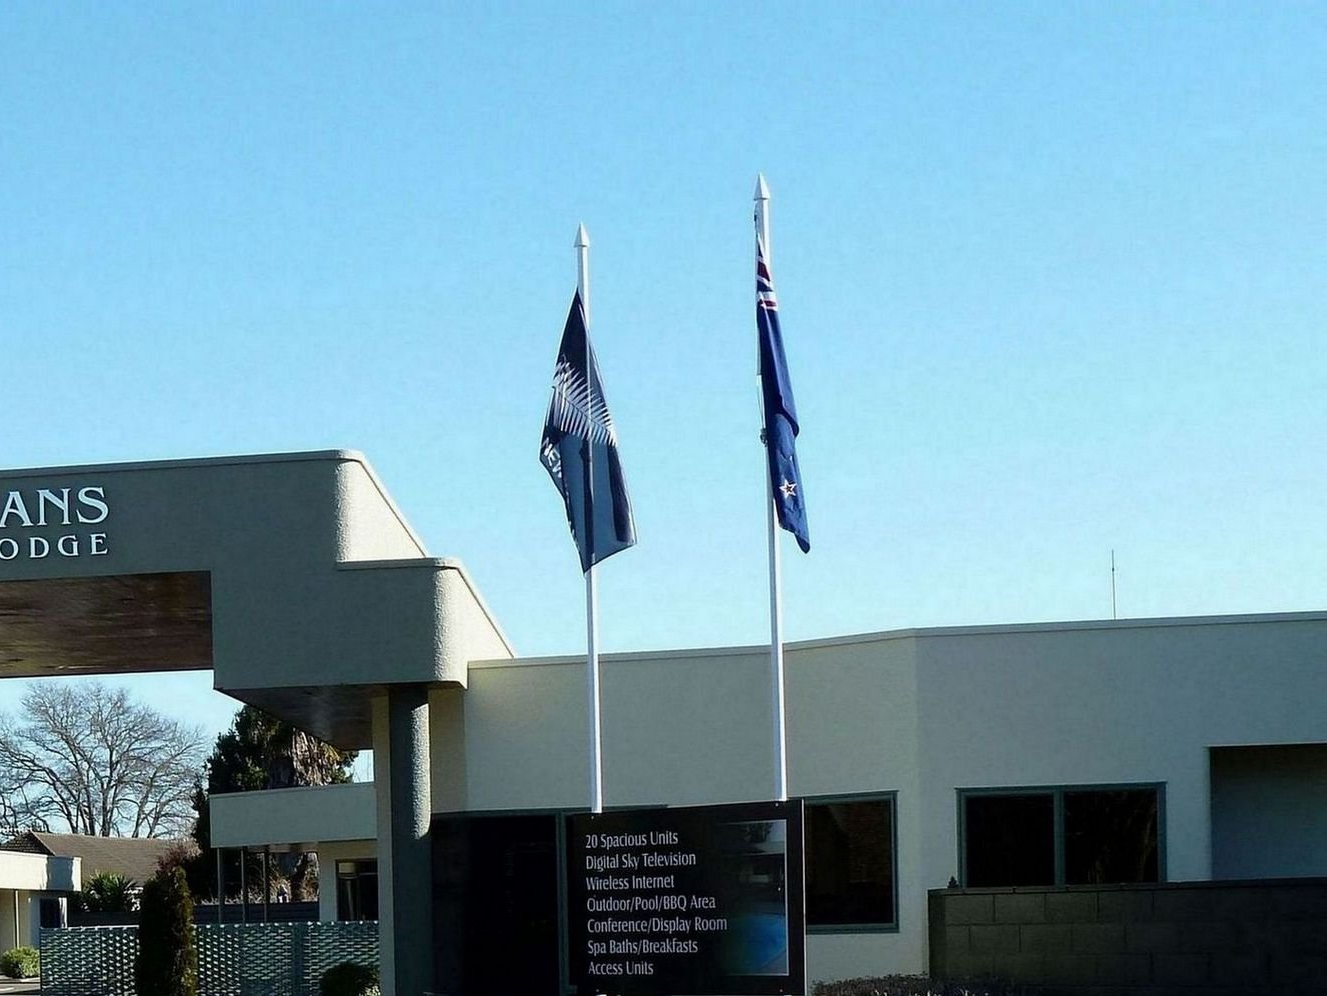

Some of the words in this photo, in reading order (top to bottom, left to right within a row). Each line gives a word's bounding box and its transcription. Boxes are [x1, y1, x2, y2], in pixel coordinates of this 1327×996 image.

[585, 834, 598, 849] 20
[600, 833, 648, 850] Spacious
[650, 831, 679, 846] Units
[586, 853, 619, 872] Digital
[621, 852, 640, 870] Sky
[642, 851, 696, 867] Television
[586, 875, 629, 890] Wireless
[632, 875, 675, 889] Internet
[586, 895, 687, 912] Outdoor/Pool/BBQ
[690, 895, 716, 909] Area
[587, 916, 691, 934] Conference/Display
[694, 917, 728, 931] Room
[587, 940, 607, 956] Spa
[609, 938, 699, 955] Baths/Breakfasts
[588, 961, 624, 975] Access
[626, 961, 654, 975] Units
